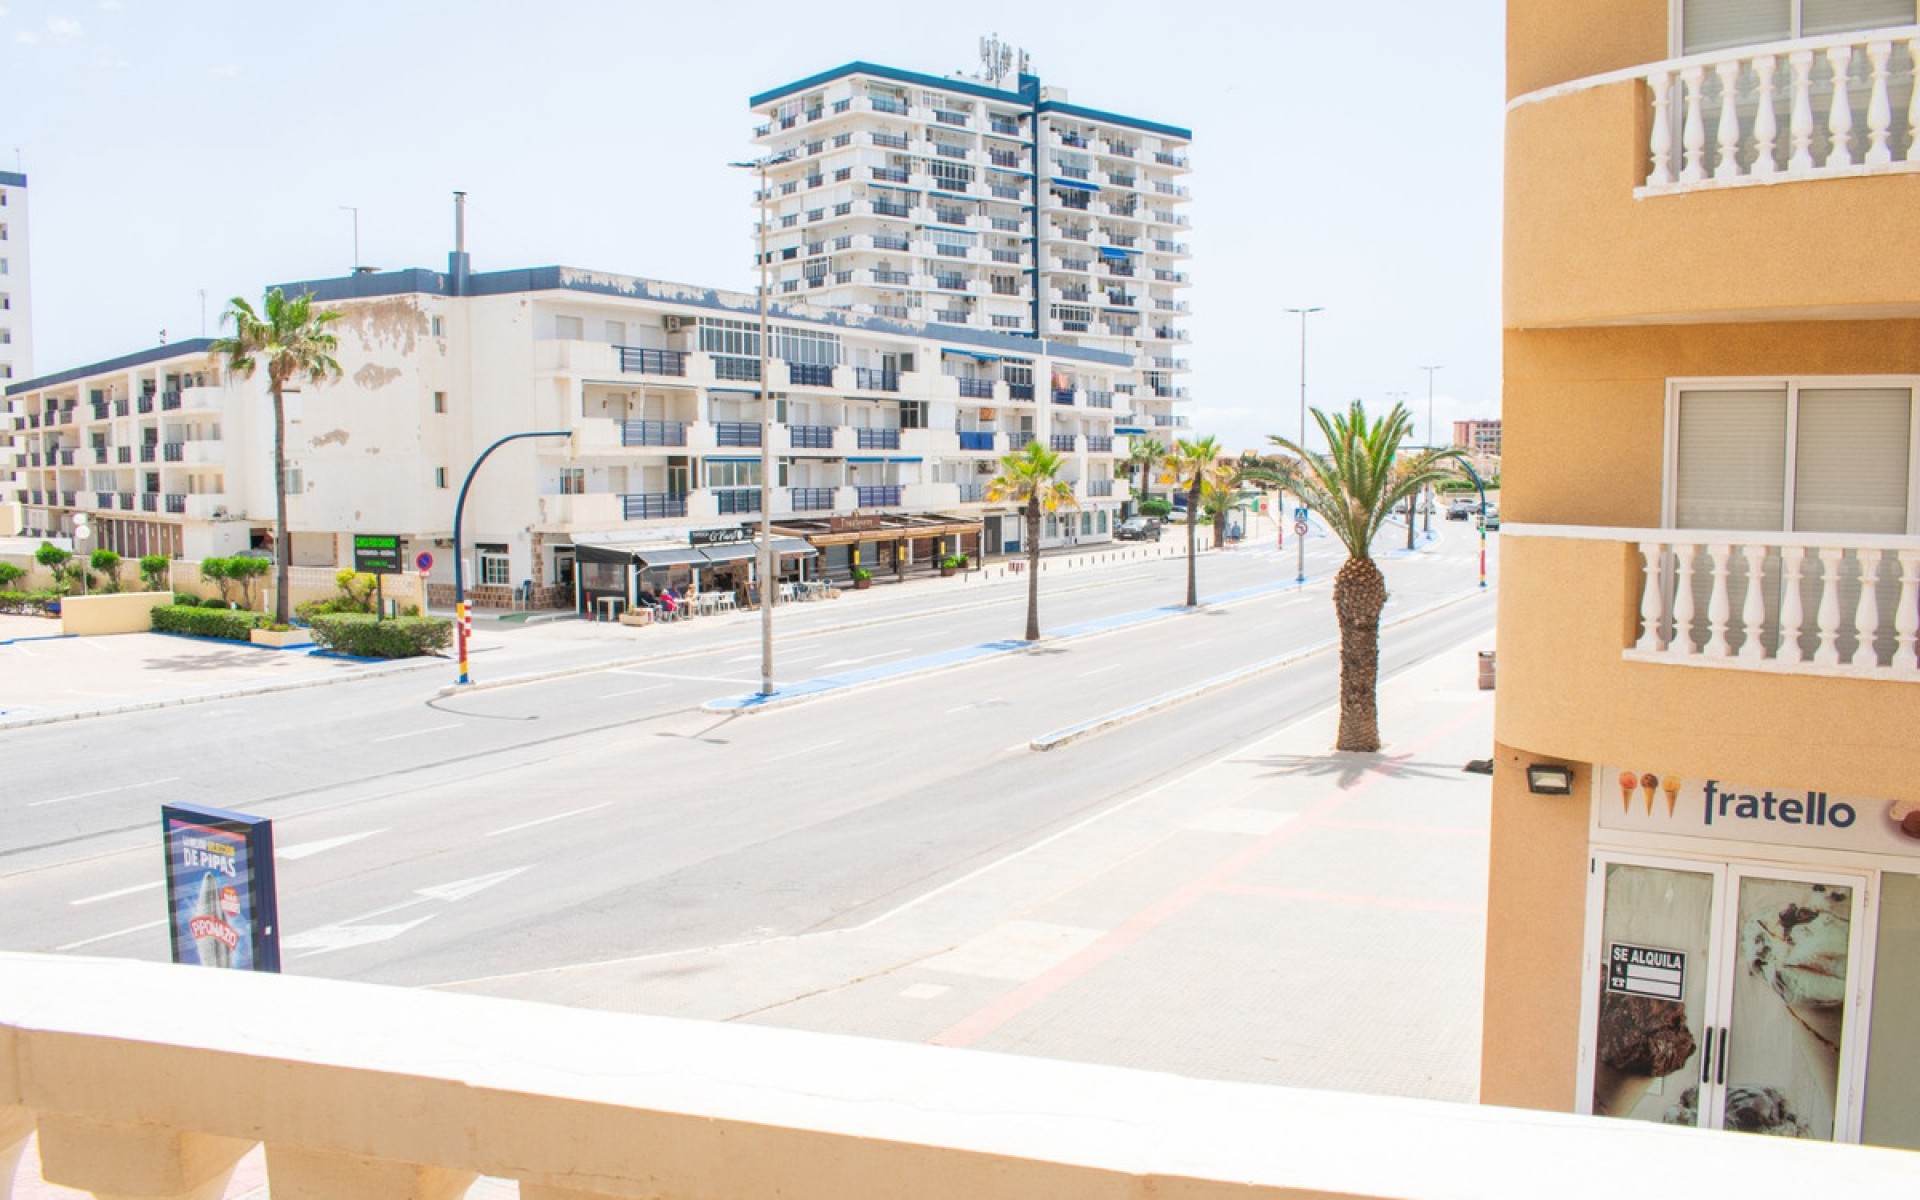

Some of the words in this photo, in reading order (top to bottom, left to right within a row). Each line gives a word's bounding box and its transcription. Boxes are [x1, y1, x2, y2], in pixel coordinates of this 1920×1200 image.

[1703, 779, 1856, 828] fratello
[183, 847, 199, 867] DE
[200, 850, 236, 878] PIPAS
[1613, 946, 1629, 962] SE
[1631, 949, 1682, 969] ALQUILA
